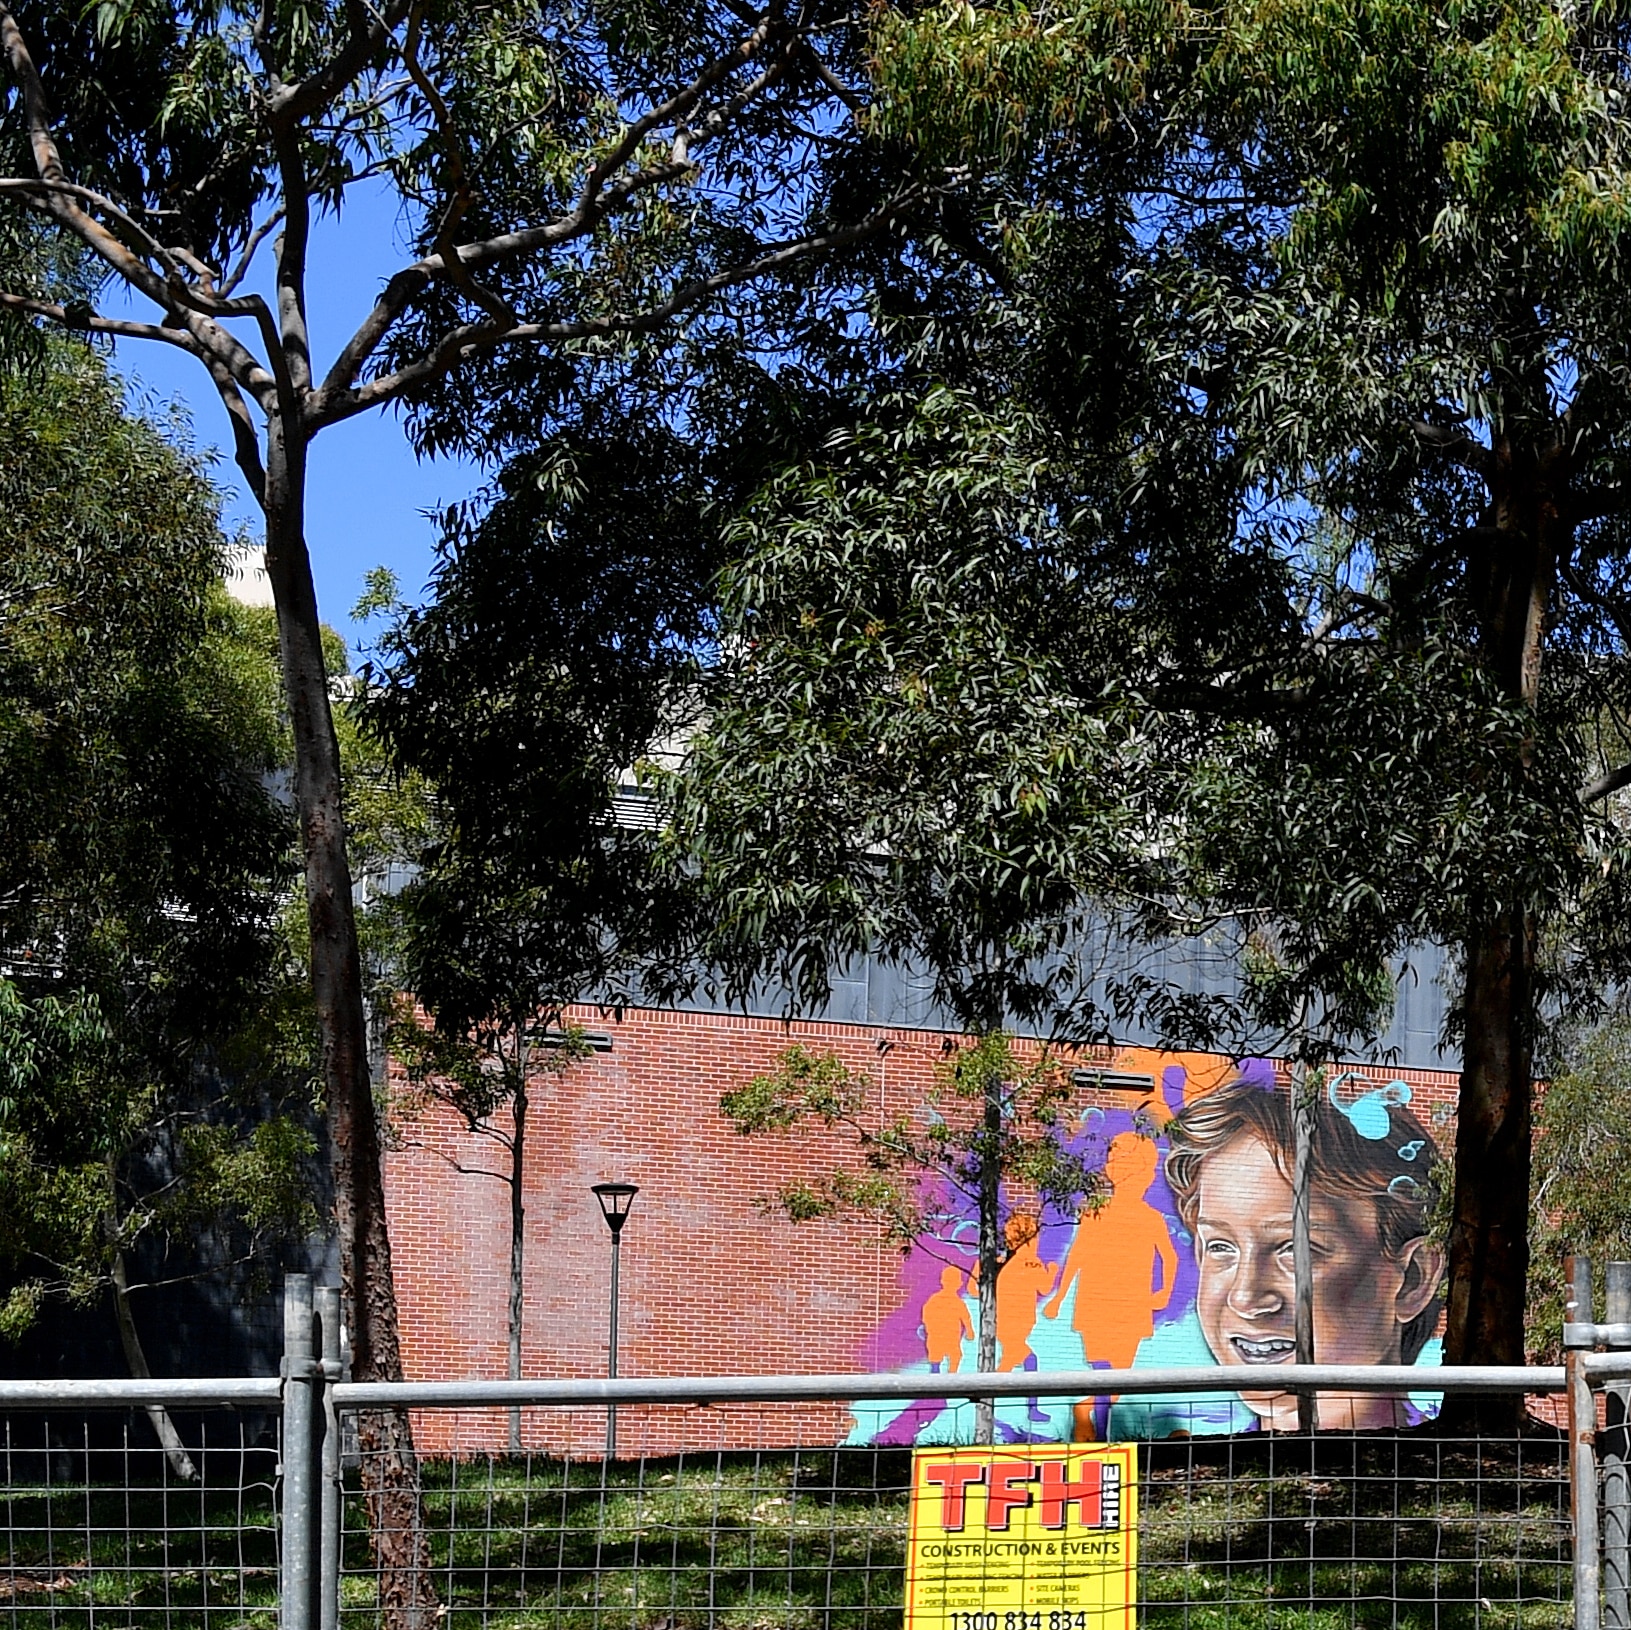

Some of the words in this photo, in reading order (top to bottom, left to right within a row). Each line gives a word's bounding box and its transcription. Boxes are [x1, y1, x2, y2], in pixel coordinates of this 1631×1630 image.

[926, 1460, 1103, 1532] TFH
[921, 1543, 1042, 1558] CONSTRUCTION
[1045, 1543, 1057, 1556] &
[1061, 1542, 1121, 1555] EVENTS
